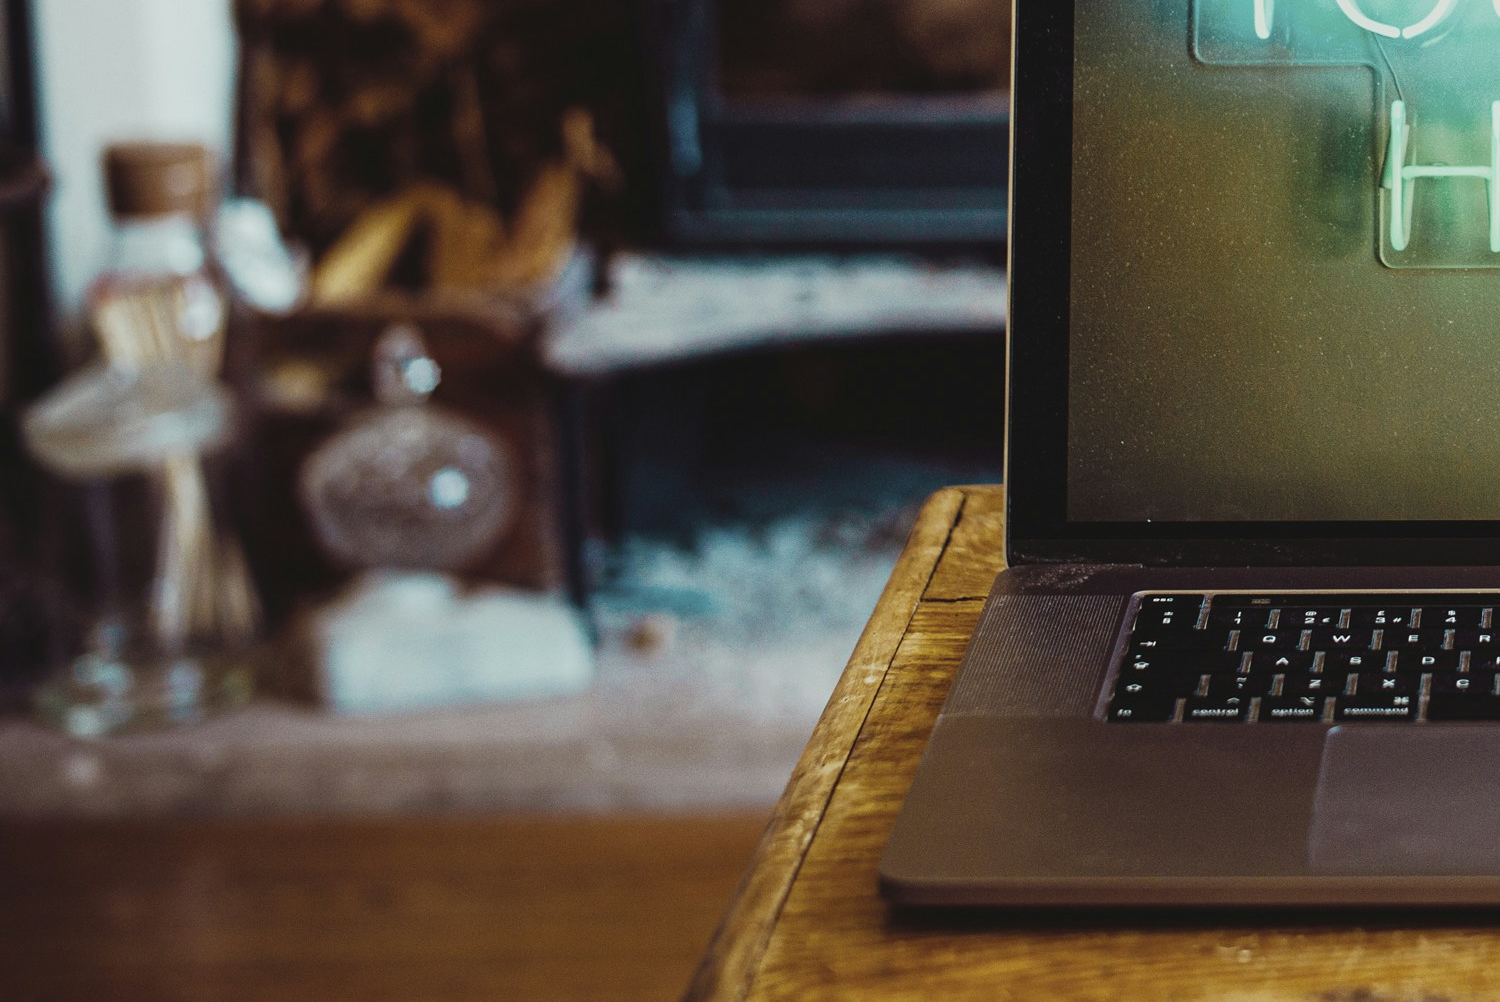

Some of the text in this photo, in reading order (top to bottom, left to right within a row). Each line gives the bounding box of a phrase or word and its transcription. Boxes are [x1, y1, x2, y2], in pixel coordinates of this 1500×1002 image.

[1262, 634, 1277, 644] Q
[1332, 634, 1351, 643] W
[1407, 634, 1419, 643] E
[1478, 634, 1491, 643] R
[1275, 656, 1289, 666] A
[1349, 656, 1362, 665] S
[1421, 656, 1436, 665] D
[1308, 679, 1322, 689] Z
[1382, 678, 1396, 688] X
[1455, 678, 1470, 689] C
[1192, 708, 1239, 717] control
[1271, 708, 1314, 718] option
[1343, 706, 1410, 716] command
